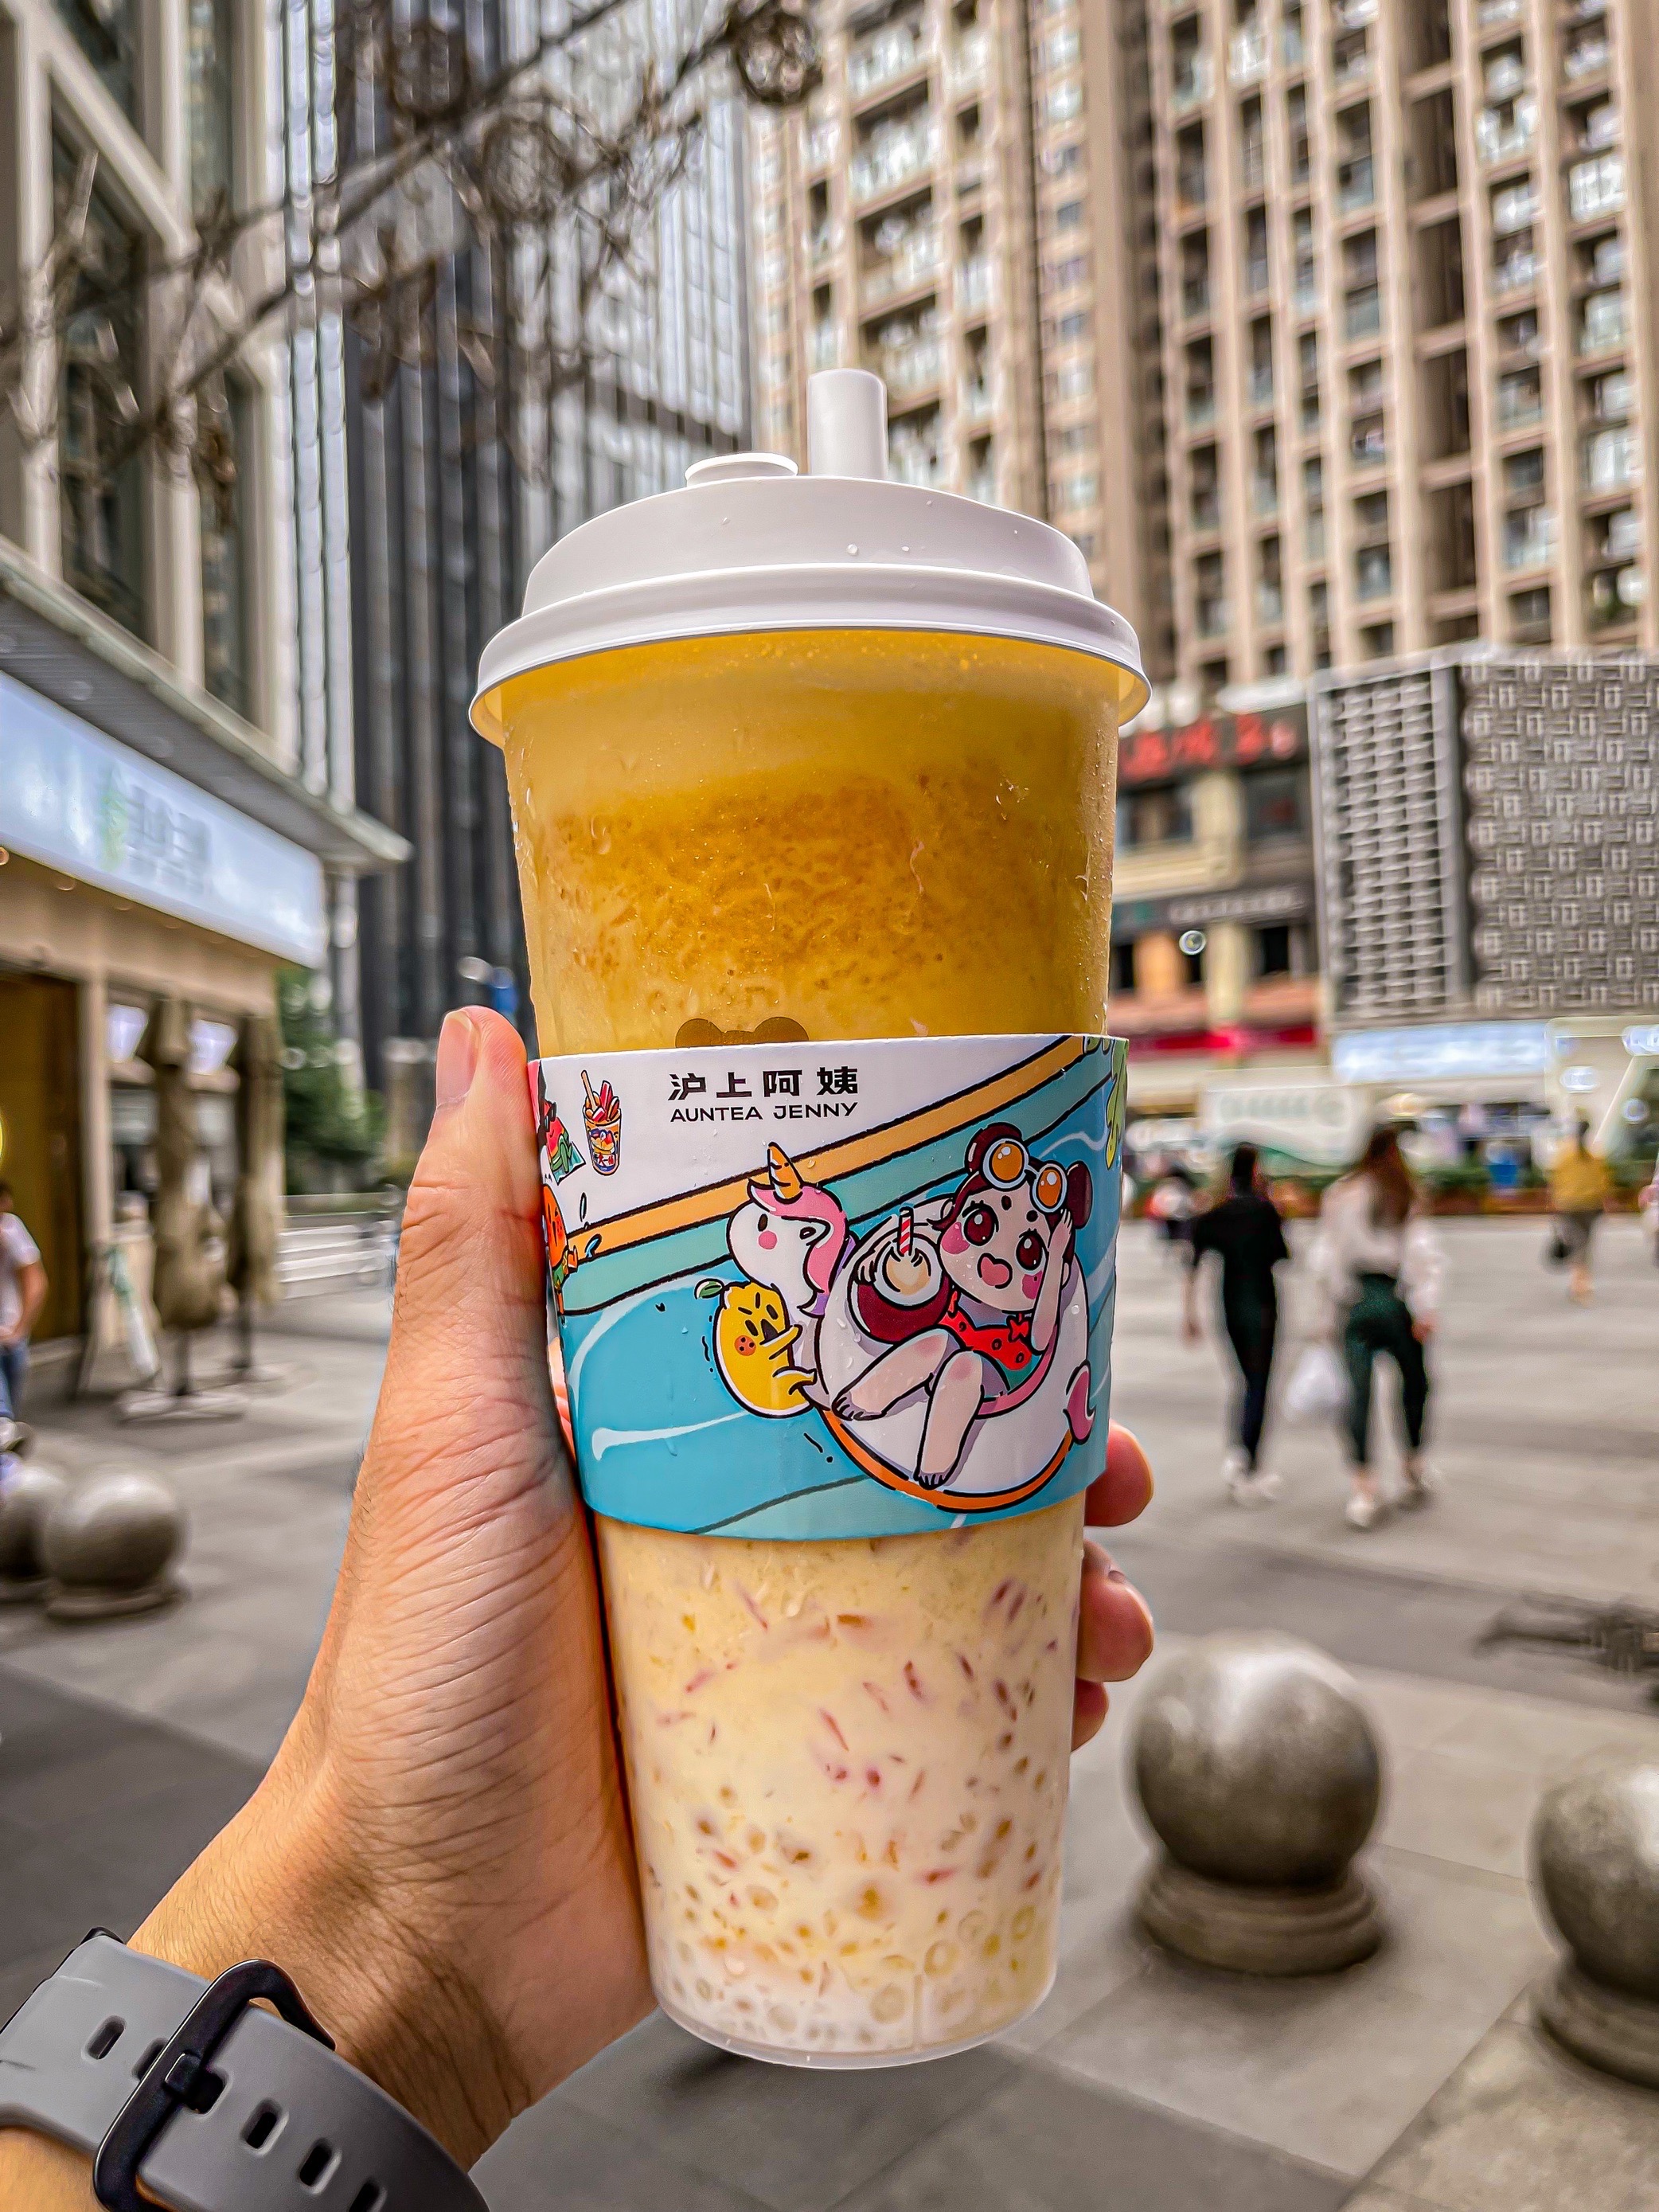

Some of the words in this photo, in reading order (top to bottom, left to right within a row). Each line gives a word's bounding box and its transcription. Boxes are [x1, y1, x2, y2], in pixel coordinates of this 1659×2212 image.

[667, 1065, 858, 1101] 沪上阿姨
[669, 1106, 763, 1123] AUNTEA
[772, 1101, 858, 1120] JENNY
